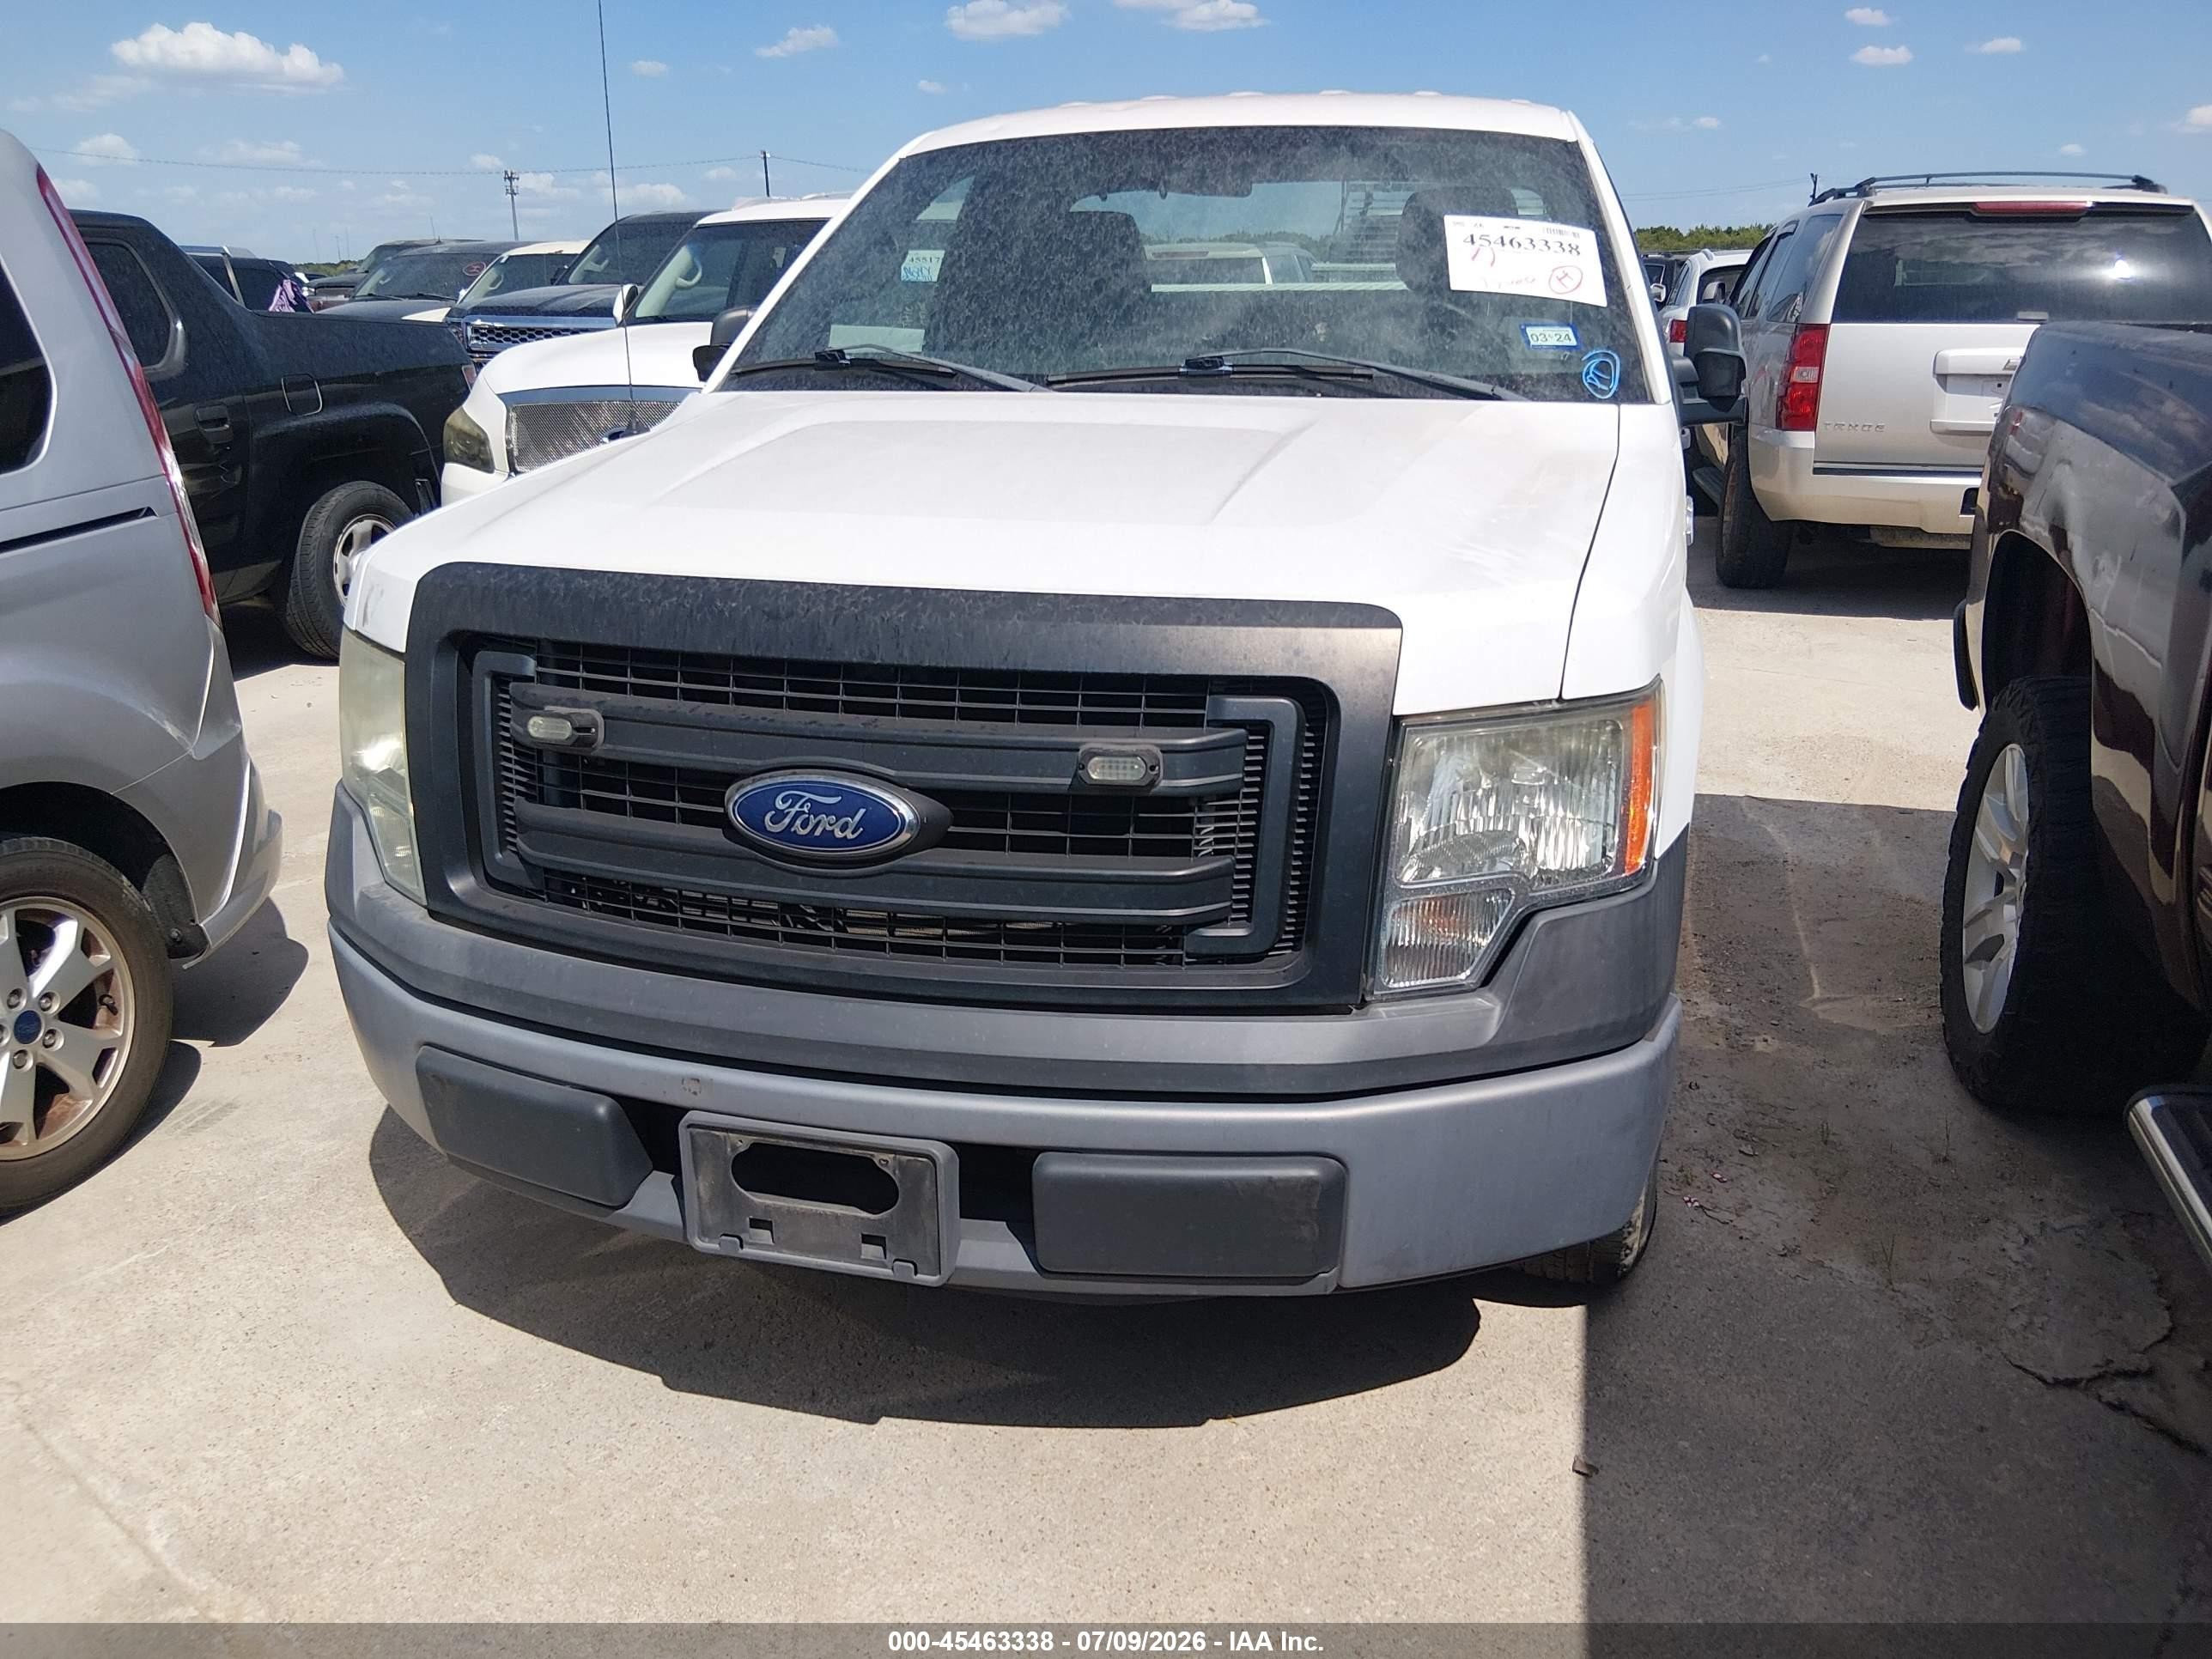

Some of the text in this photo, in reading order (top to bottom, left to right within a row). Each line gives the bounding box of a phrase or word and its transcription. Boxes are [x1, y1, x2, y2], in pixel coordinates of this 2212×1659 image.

[1462, 234, 1581, 257] 45463338
[1530, 333, 1571, 343] 03 24
[1823, 421, 1886, 433] TAHOE
[764, 790, 866, 840] Ford
